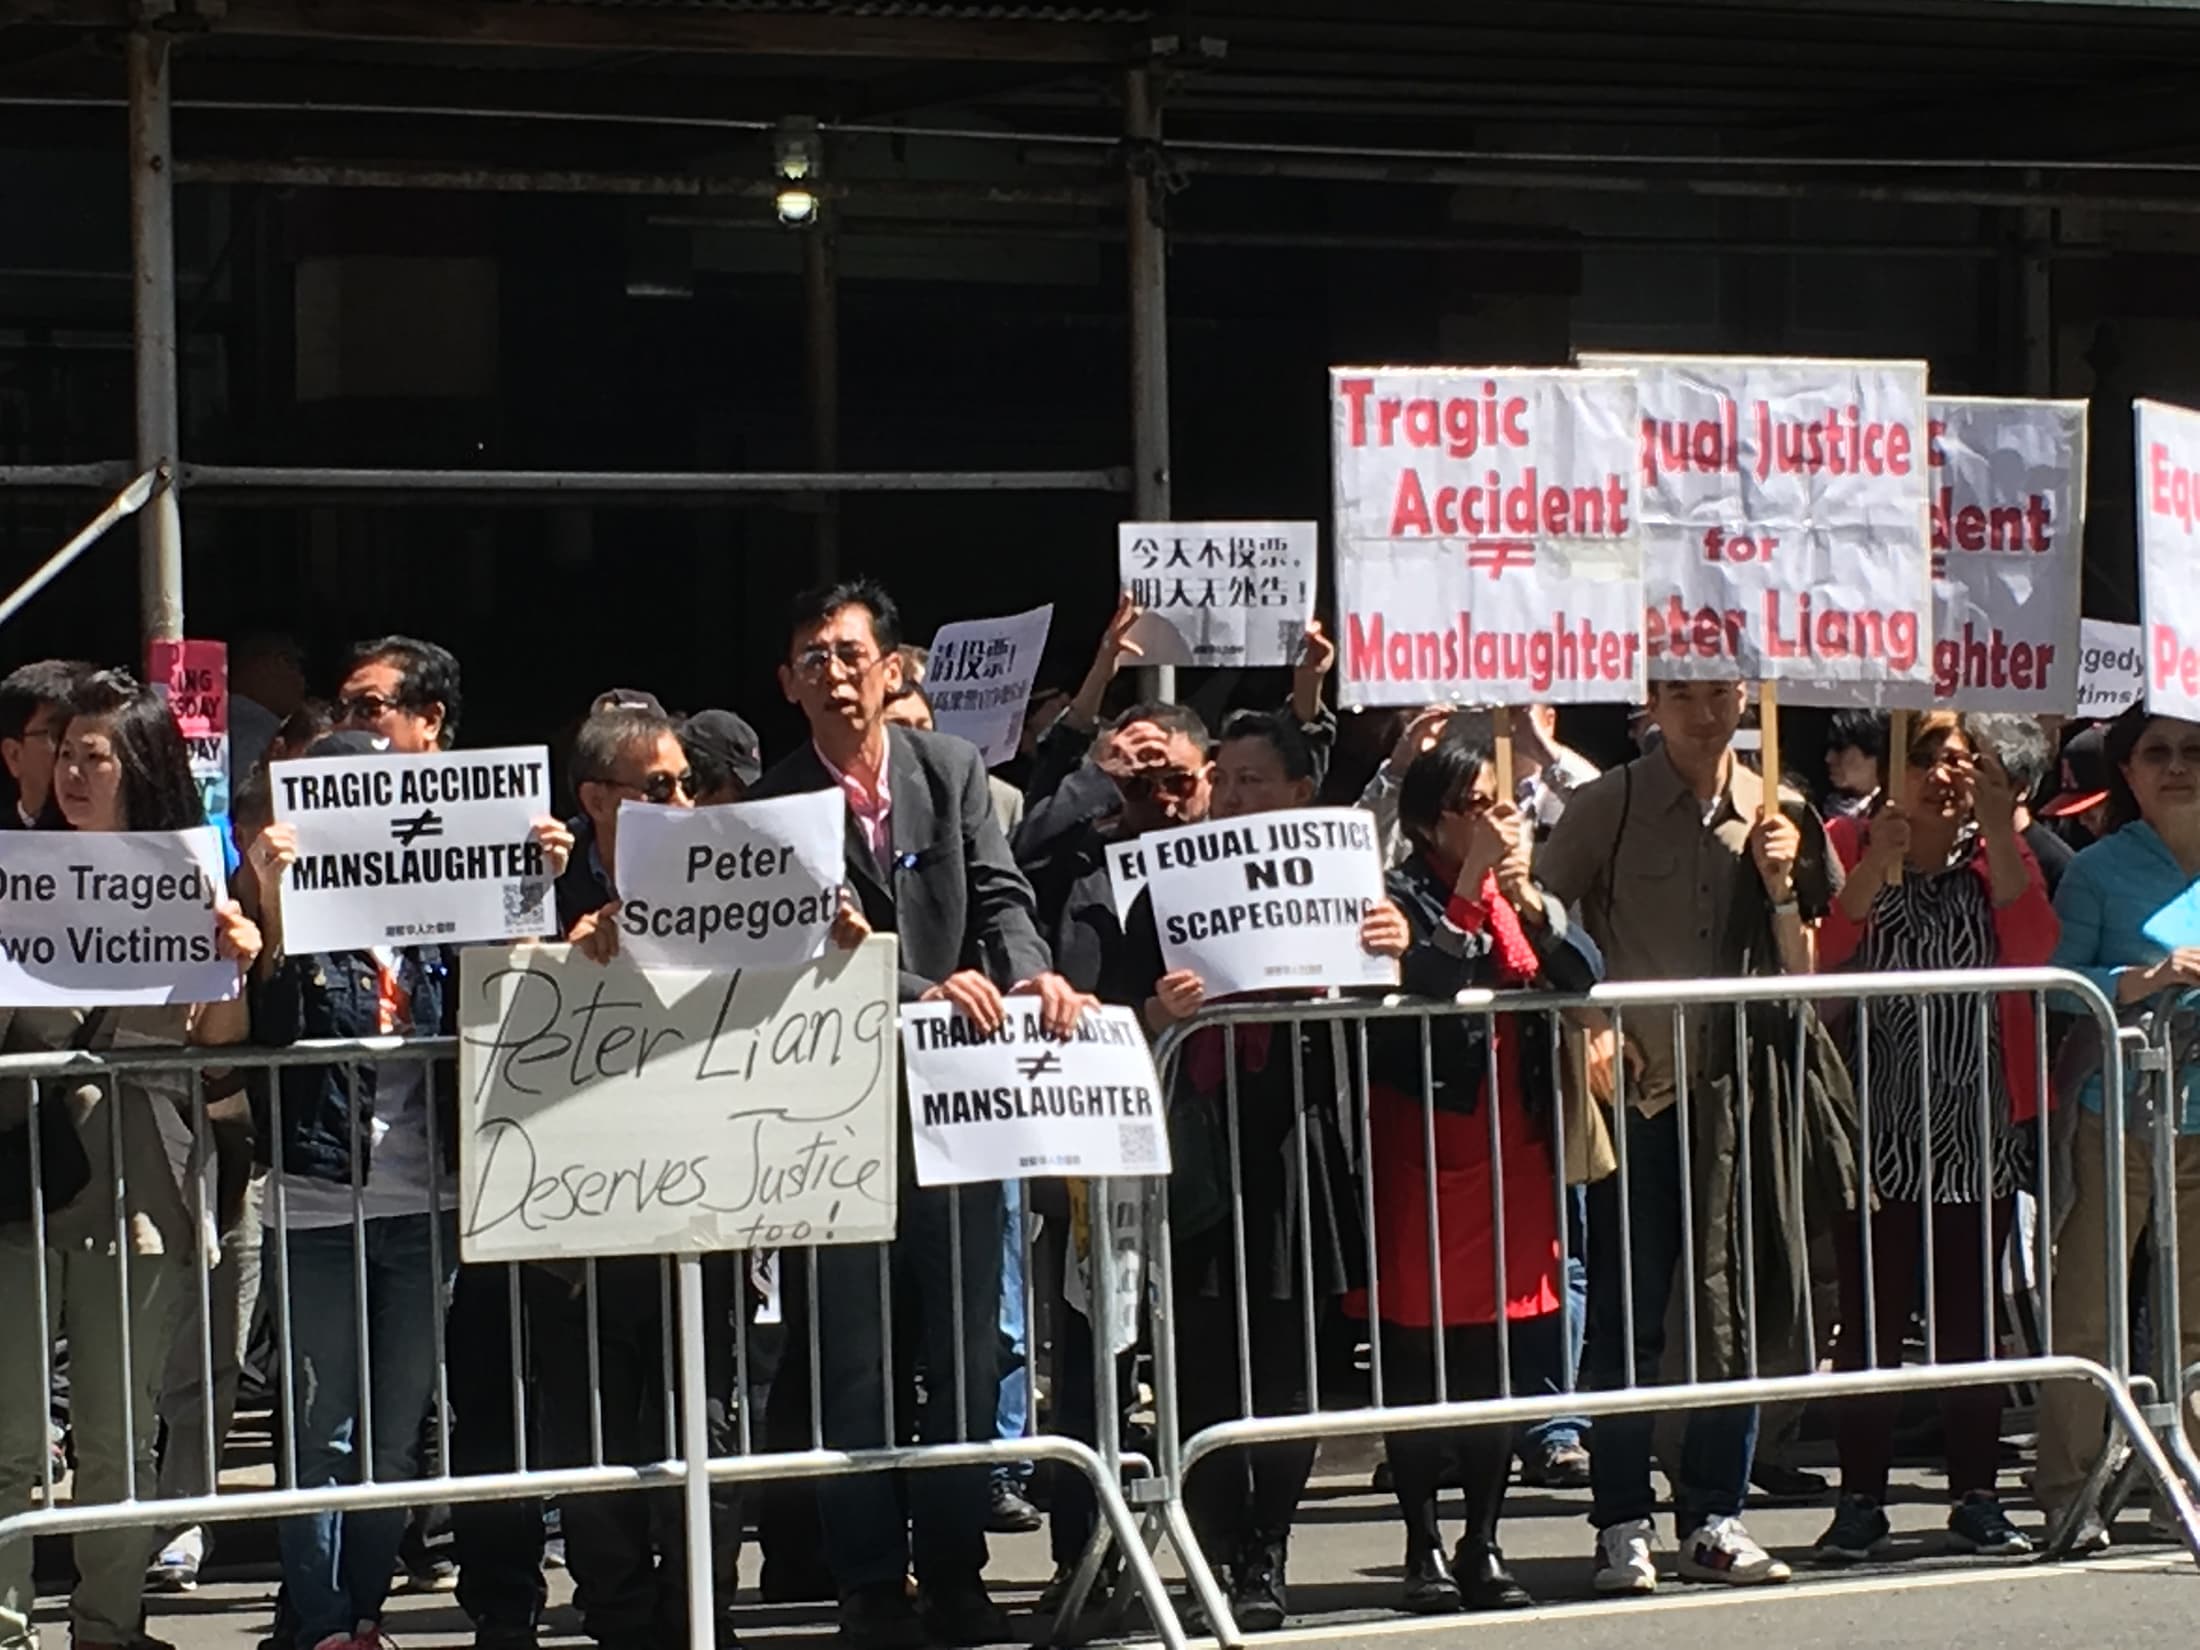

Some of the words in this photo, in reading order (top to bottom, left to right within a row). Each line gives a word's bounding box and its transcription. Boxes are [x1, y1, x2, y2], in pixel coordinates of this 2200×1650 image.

[1340, 378, 1530, 459] Tragic
[1642, 398, 1738, 488] qual
[1754, 399, 1911, 485] Justice
[1389, 468, 1630, 538] Accident
[1930, 486, 2052, 553] dent
[1703, 526, 1780, 563] for
[1346, 610, 1639, 692] Manslaughter
[1646, 594, 1746, 659] eter
[1763, 588, 1919, 672] Liang
[2080, 647, 2144, 679] gedy
[282, 771, 393, 811] TRAGIC
[401, 763, 542, 804] ACCIDENT
[292, 841, 544, 891] MANSLAUGHTER
[687, 843, 795, 883] Peter
[1156, 827, 1262, 870] EQUAL
[1268, 821, 1373, 852] JUSTICE
[0, 866, 56, 901] ne
[69, 865, 216, 910] Tragedy
[1244, 857, 1314, 891] NO
[0, 929, 56, 964] wo
[465, 969, 685, 1105] Peter
[696, 968, 889, 1121] Liang
[922, 1085, 1154, 1127] MANSLAUGHTER
[461, 1116, 710, 1239] Deserves
[703, 1108, 896, 1214] Justice
[737, 1201, 841, 1248] too!
